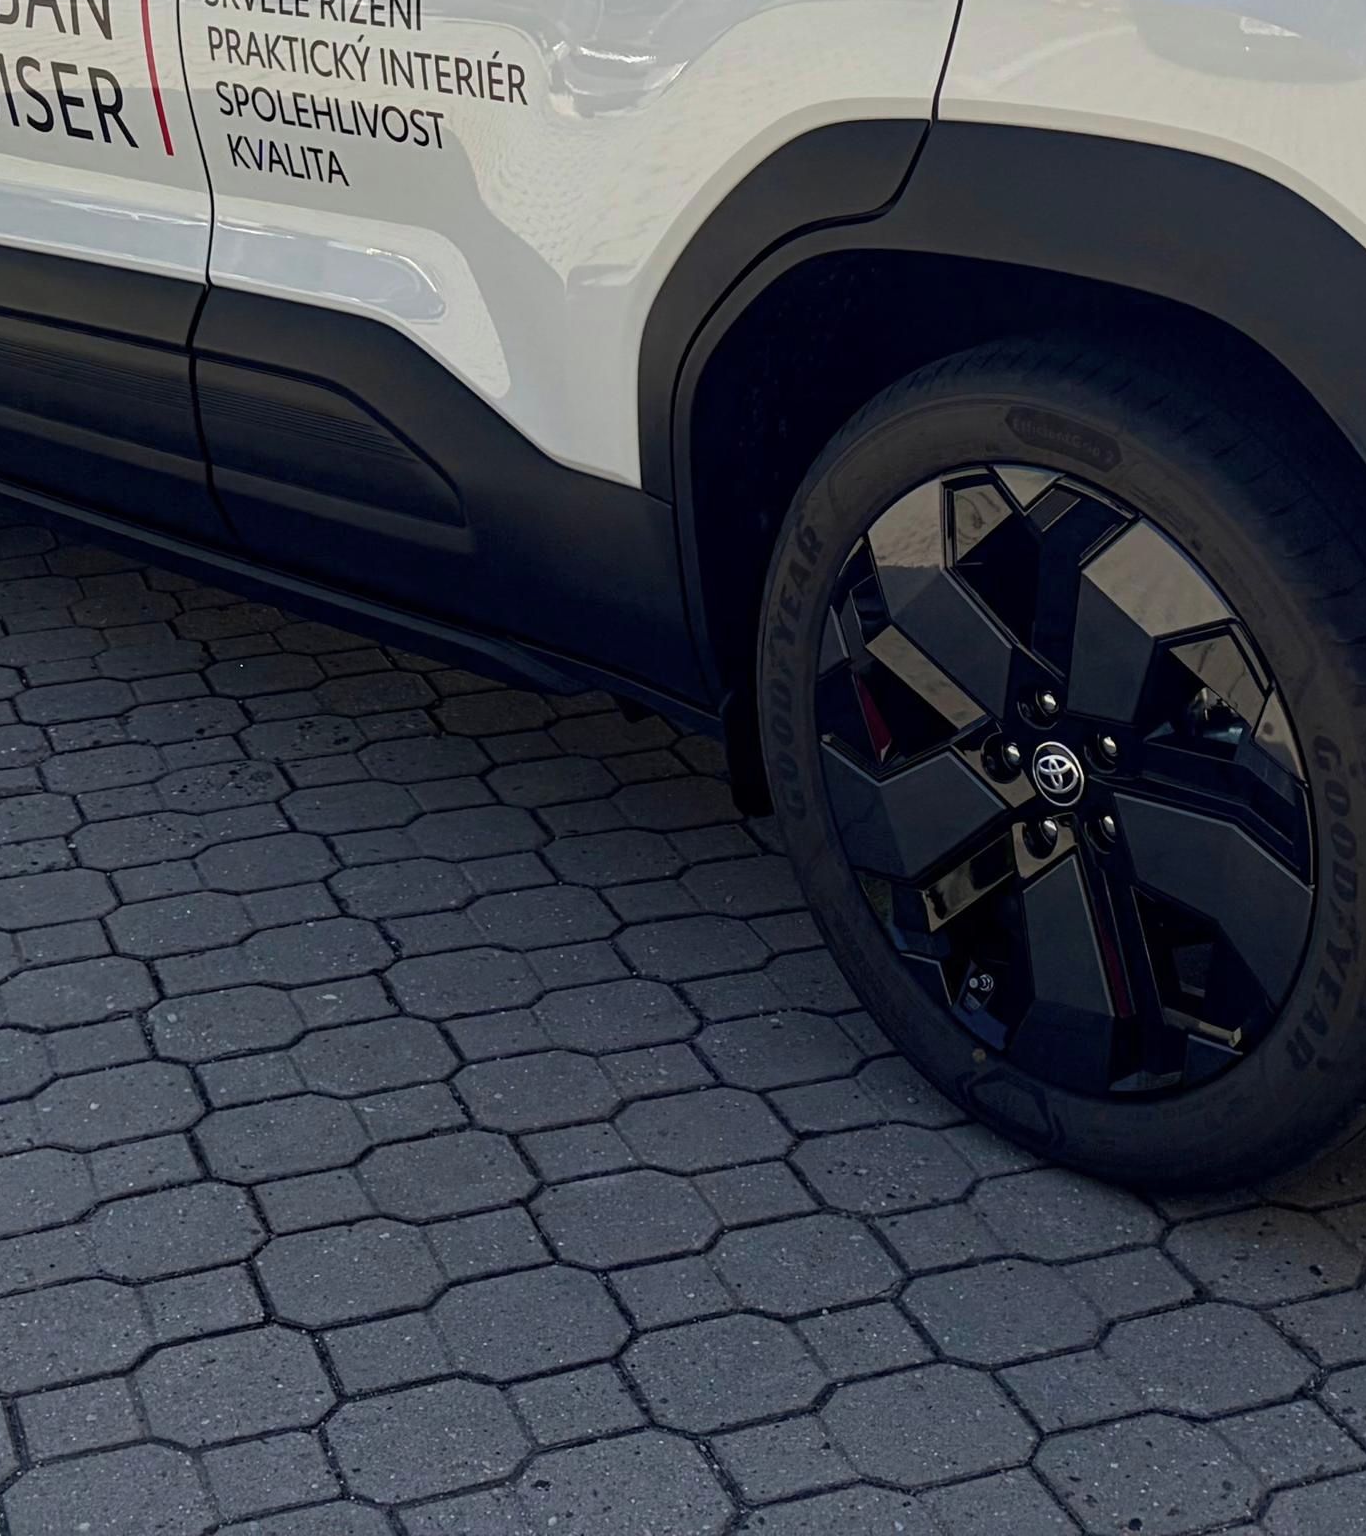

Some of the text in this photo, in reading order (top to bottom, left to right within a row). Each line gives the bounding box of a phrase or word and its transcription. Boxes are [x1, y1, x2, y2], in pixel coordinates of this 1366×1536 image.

[207, 25, 529, 106] PRAKTICKÝ INTERIÉR
[215, 80, 445, 150] SPOLEHLIVOST
[226, 133, 351, 188] KVALITA
